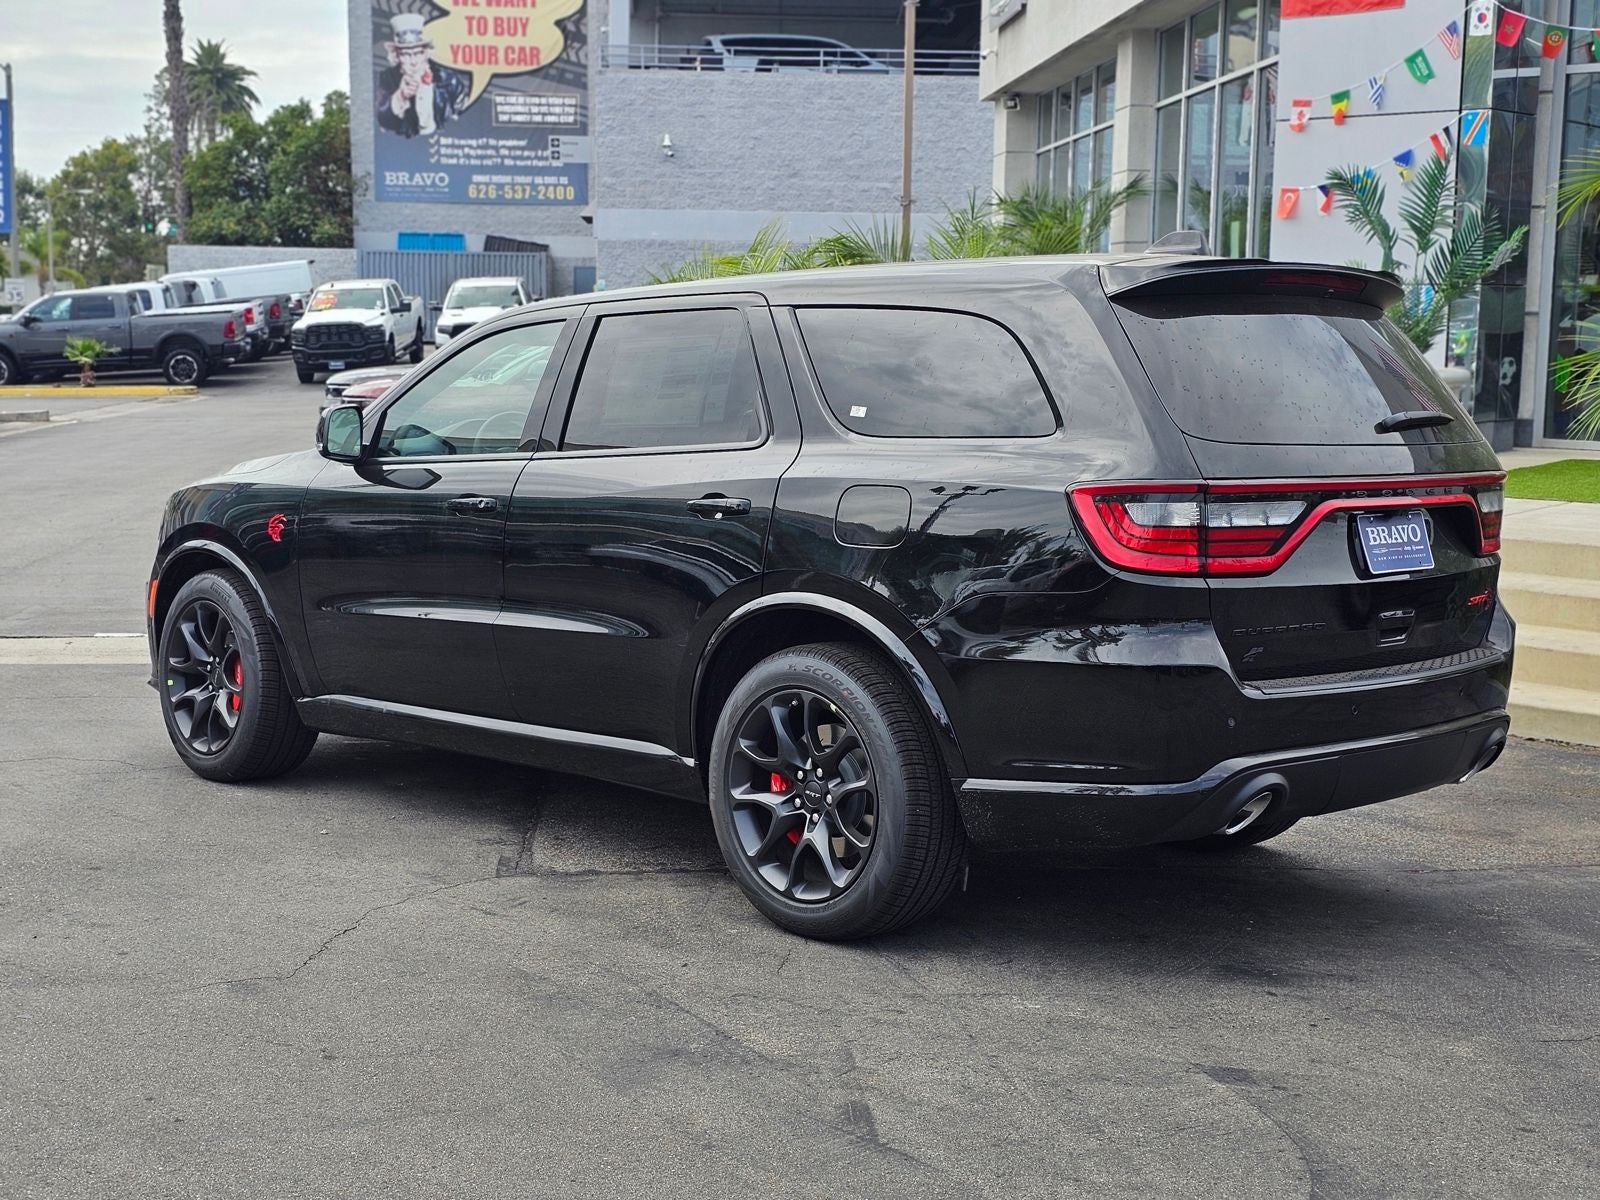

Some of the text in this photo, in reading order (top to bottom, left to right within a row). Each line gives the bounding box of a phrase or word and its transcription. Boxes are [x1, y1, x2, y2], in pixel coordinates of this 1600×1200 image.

[464, 15, 529, 38] TO BUY
[450, 44, 541, 67] YOUR CAR
[384, 171, 449, 187] BRAVO
[468, 184, 575, 200] 626-537-2400
[1366, 523, 1421, 545] BRAVO
[802, 664, 875, 723] SCORPION
